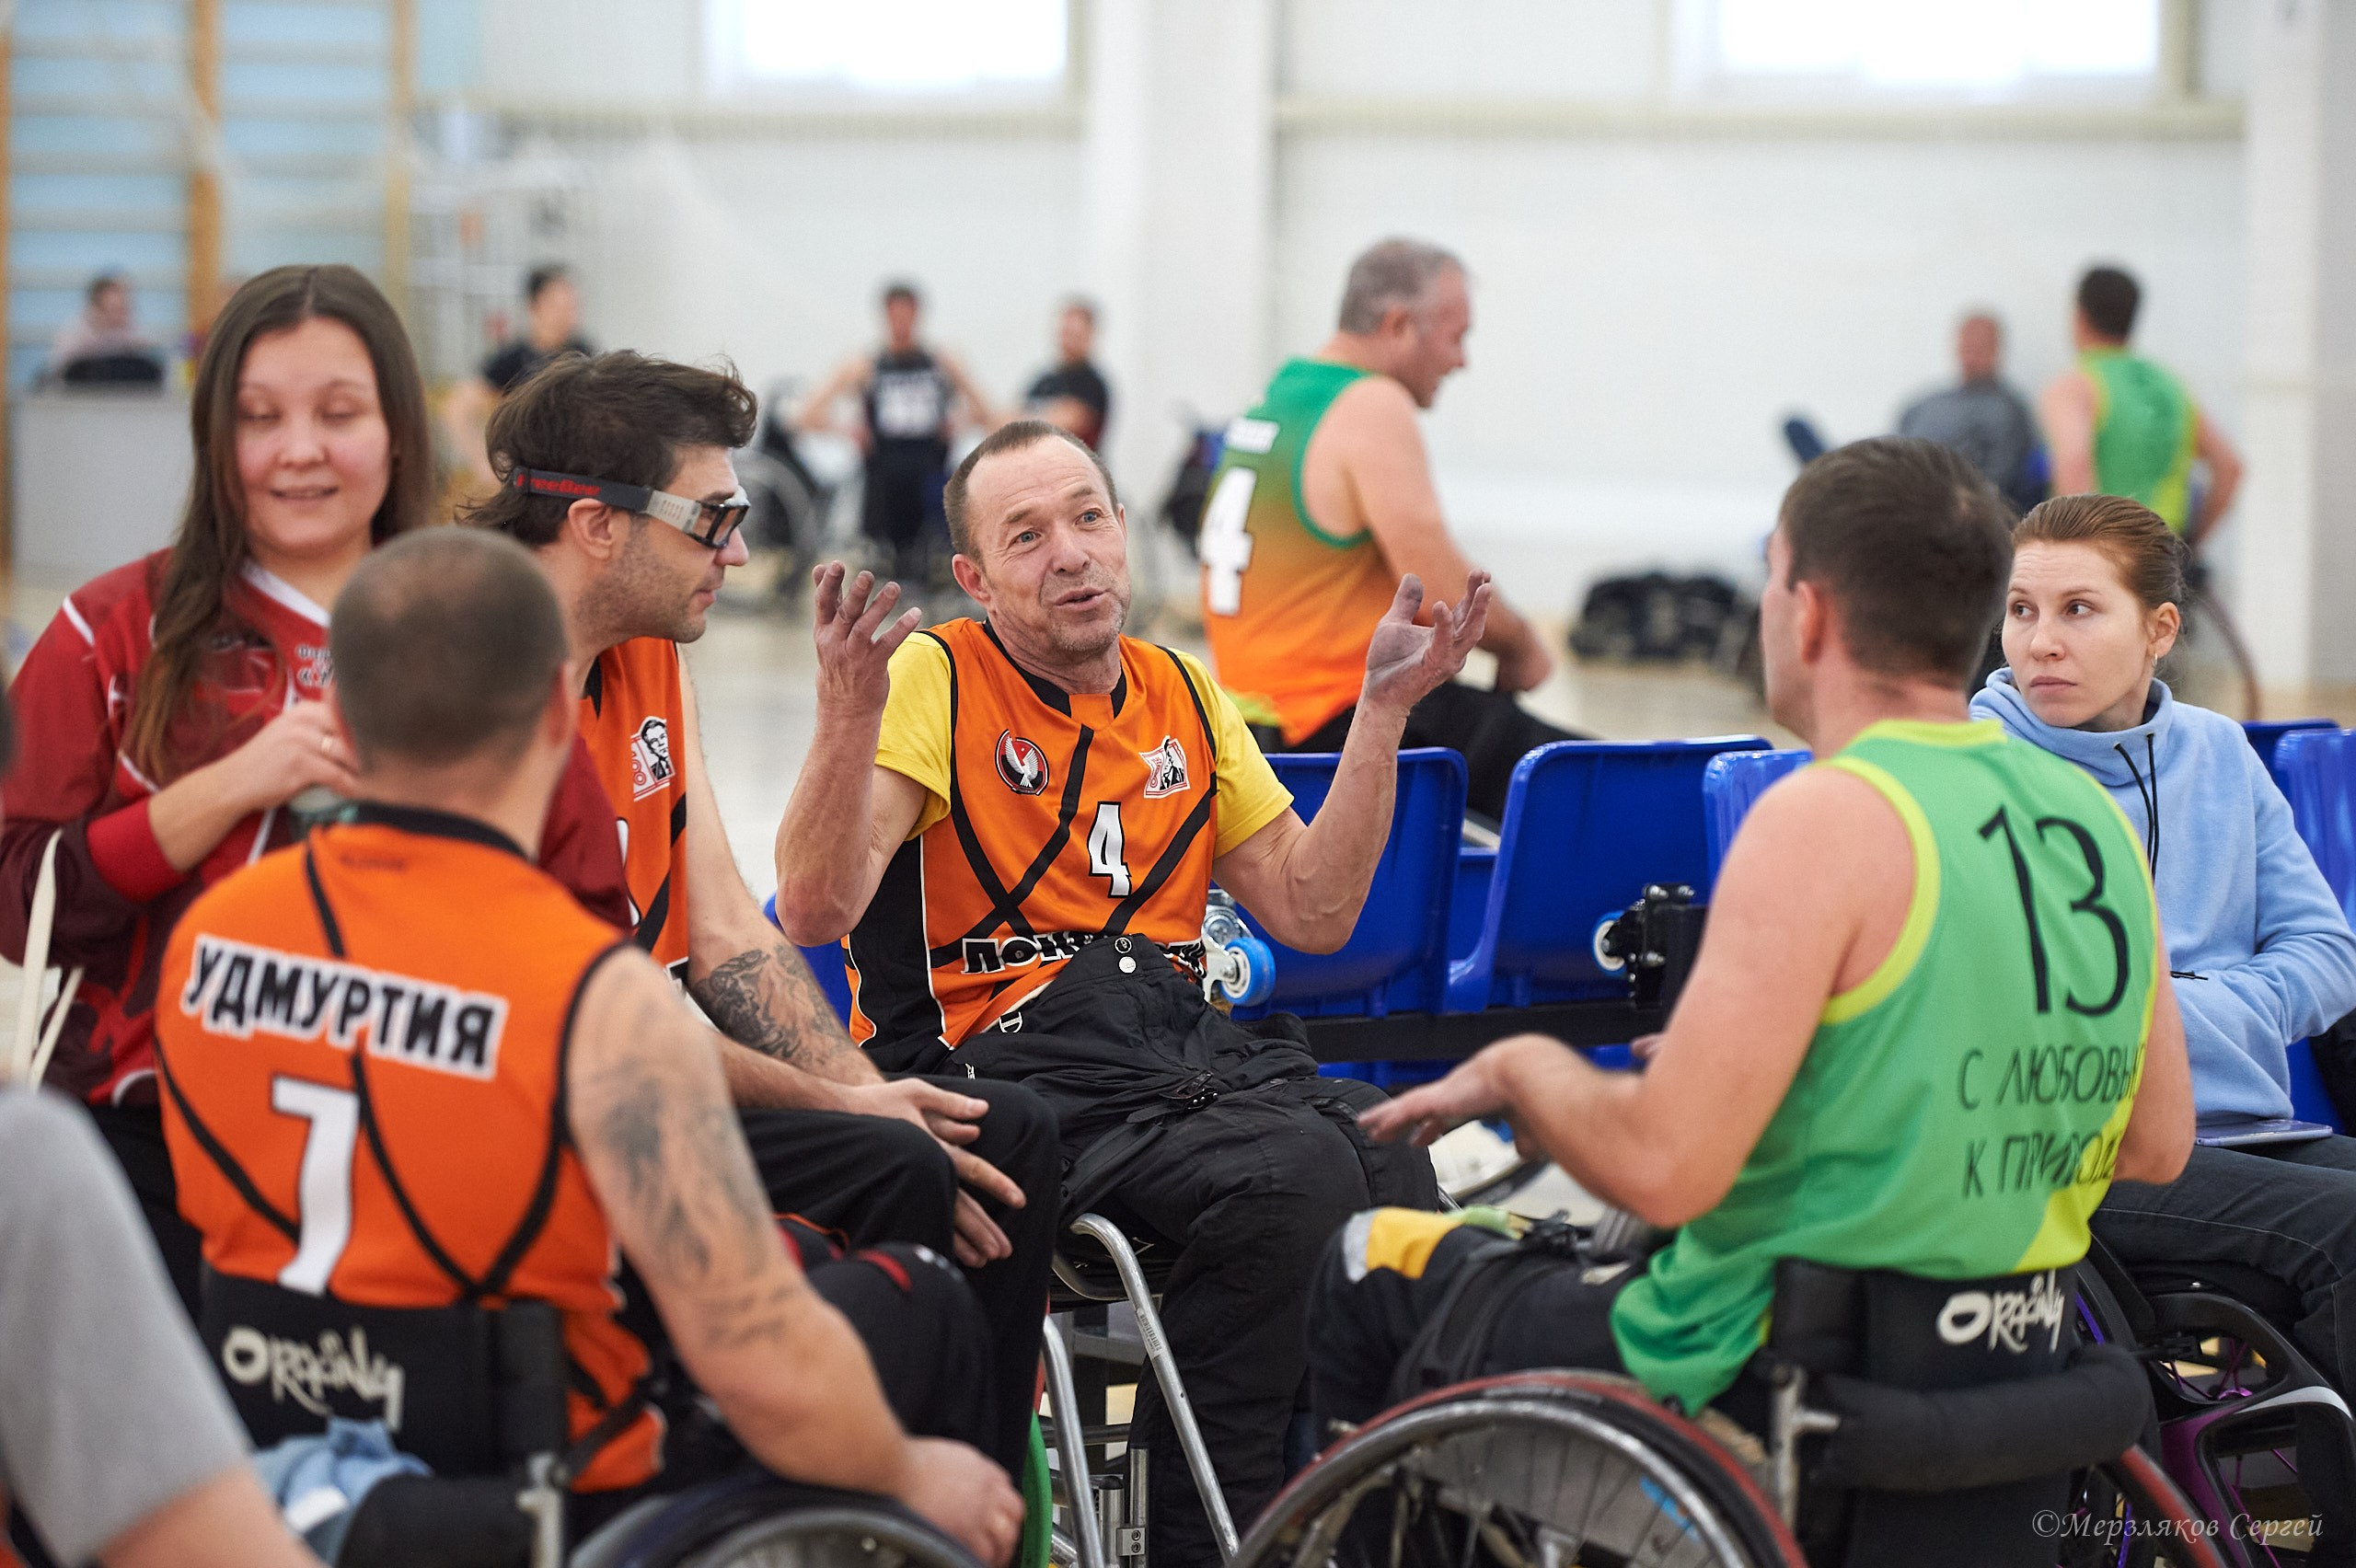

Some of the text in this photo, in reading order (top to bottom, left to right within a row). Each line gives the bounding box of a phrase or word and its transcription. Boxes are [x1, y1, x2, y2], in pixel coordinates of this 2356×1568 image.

[1201, 467, 1257, 616] 4
[1087, 801, 1132, 898] 4
[1978, 803, 2131, 1017] 13
[186, 939, 501, 1073] УДМУРТИЯ
[1958, 1048, 1984, 1110] С
[272, 1075, 361, 1296] 7
[1962, 1130, 2120, 1199] К ПРИРОД
